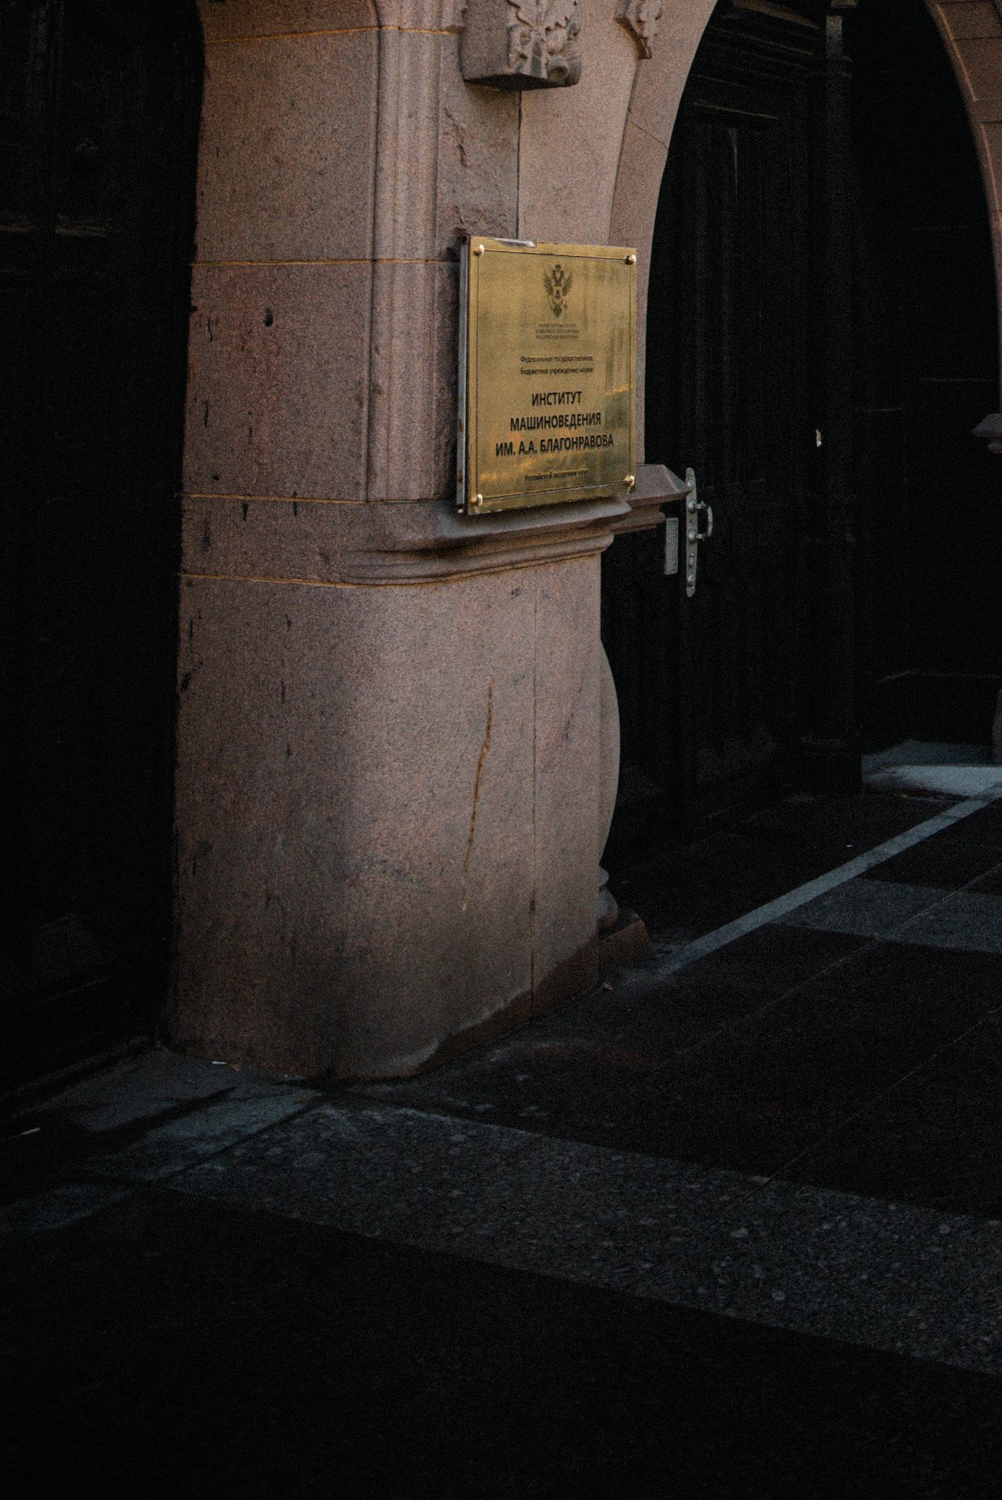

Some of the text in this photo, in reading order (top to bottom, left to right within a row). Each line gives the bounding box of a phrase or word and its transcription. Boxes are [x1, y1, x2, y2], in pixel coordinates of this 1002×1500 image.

[531, 391, 582, 406] ИНСТИТУТ
[510, 412, 601, 431] МАШИНОВЕДЕНИЯ
[495, 434, 614, 457] ИМ. А.А. БЛАГОНРАВОВА
